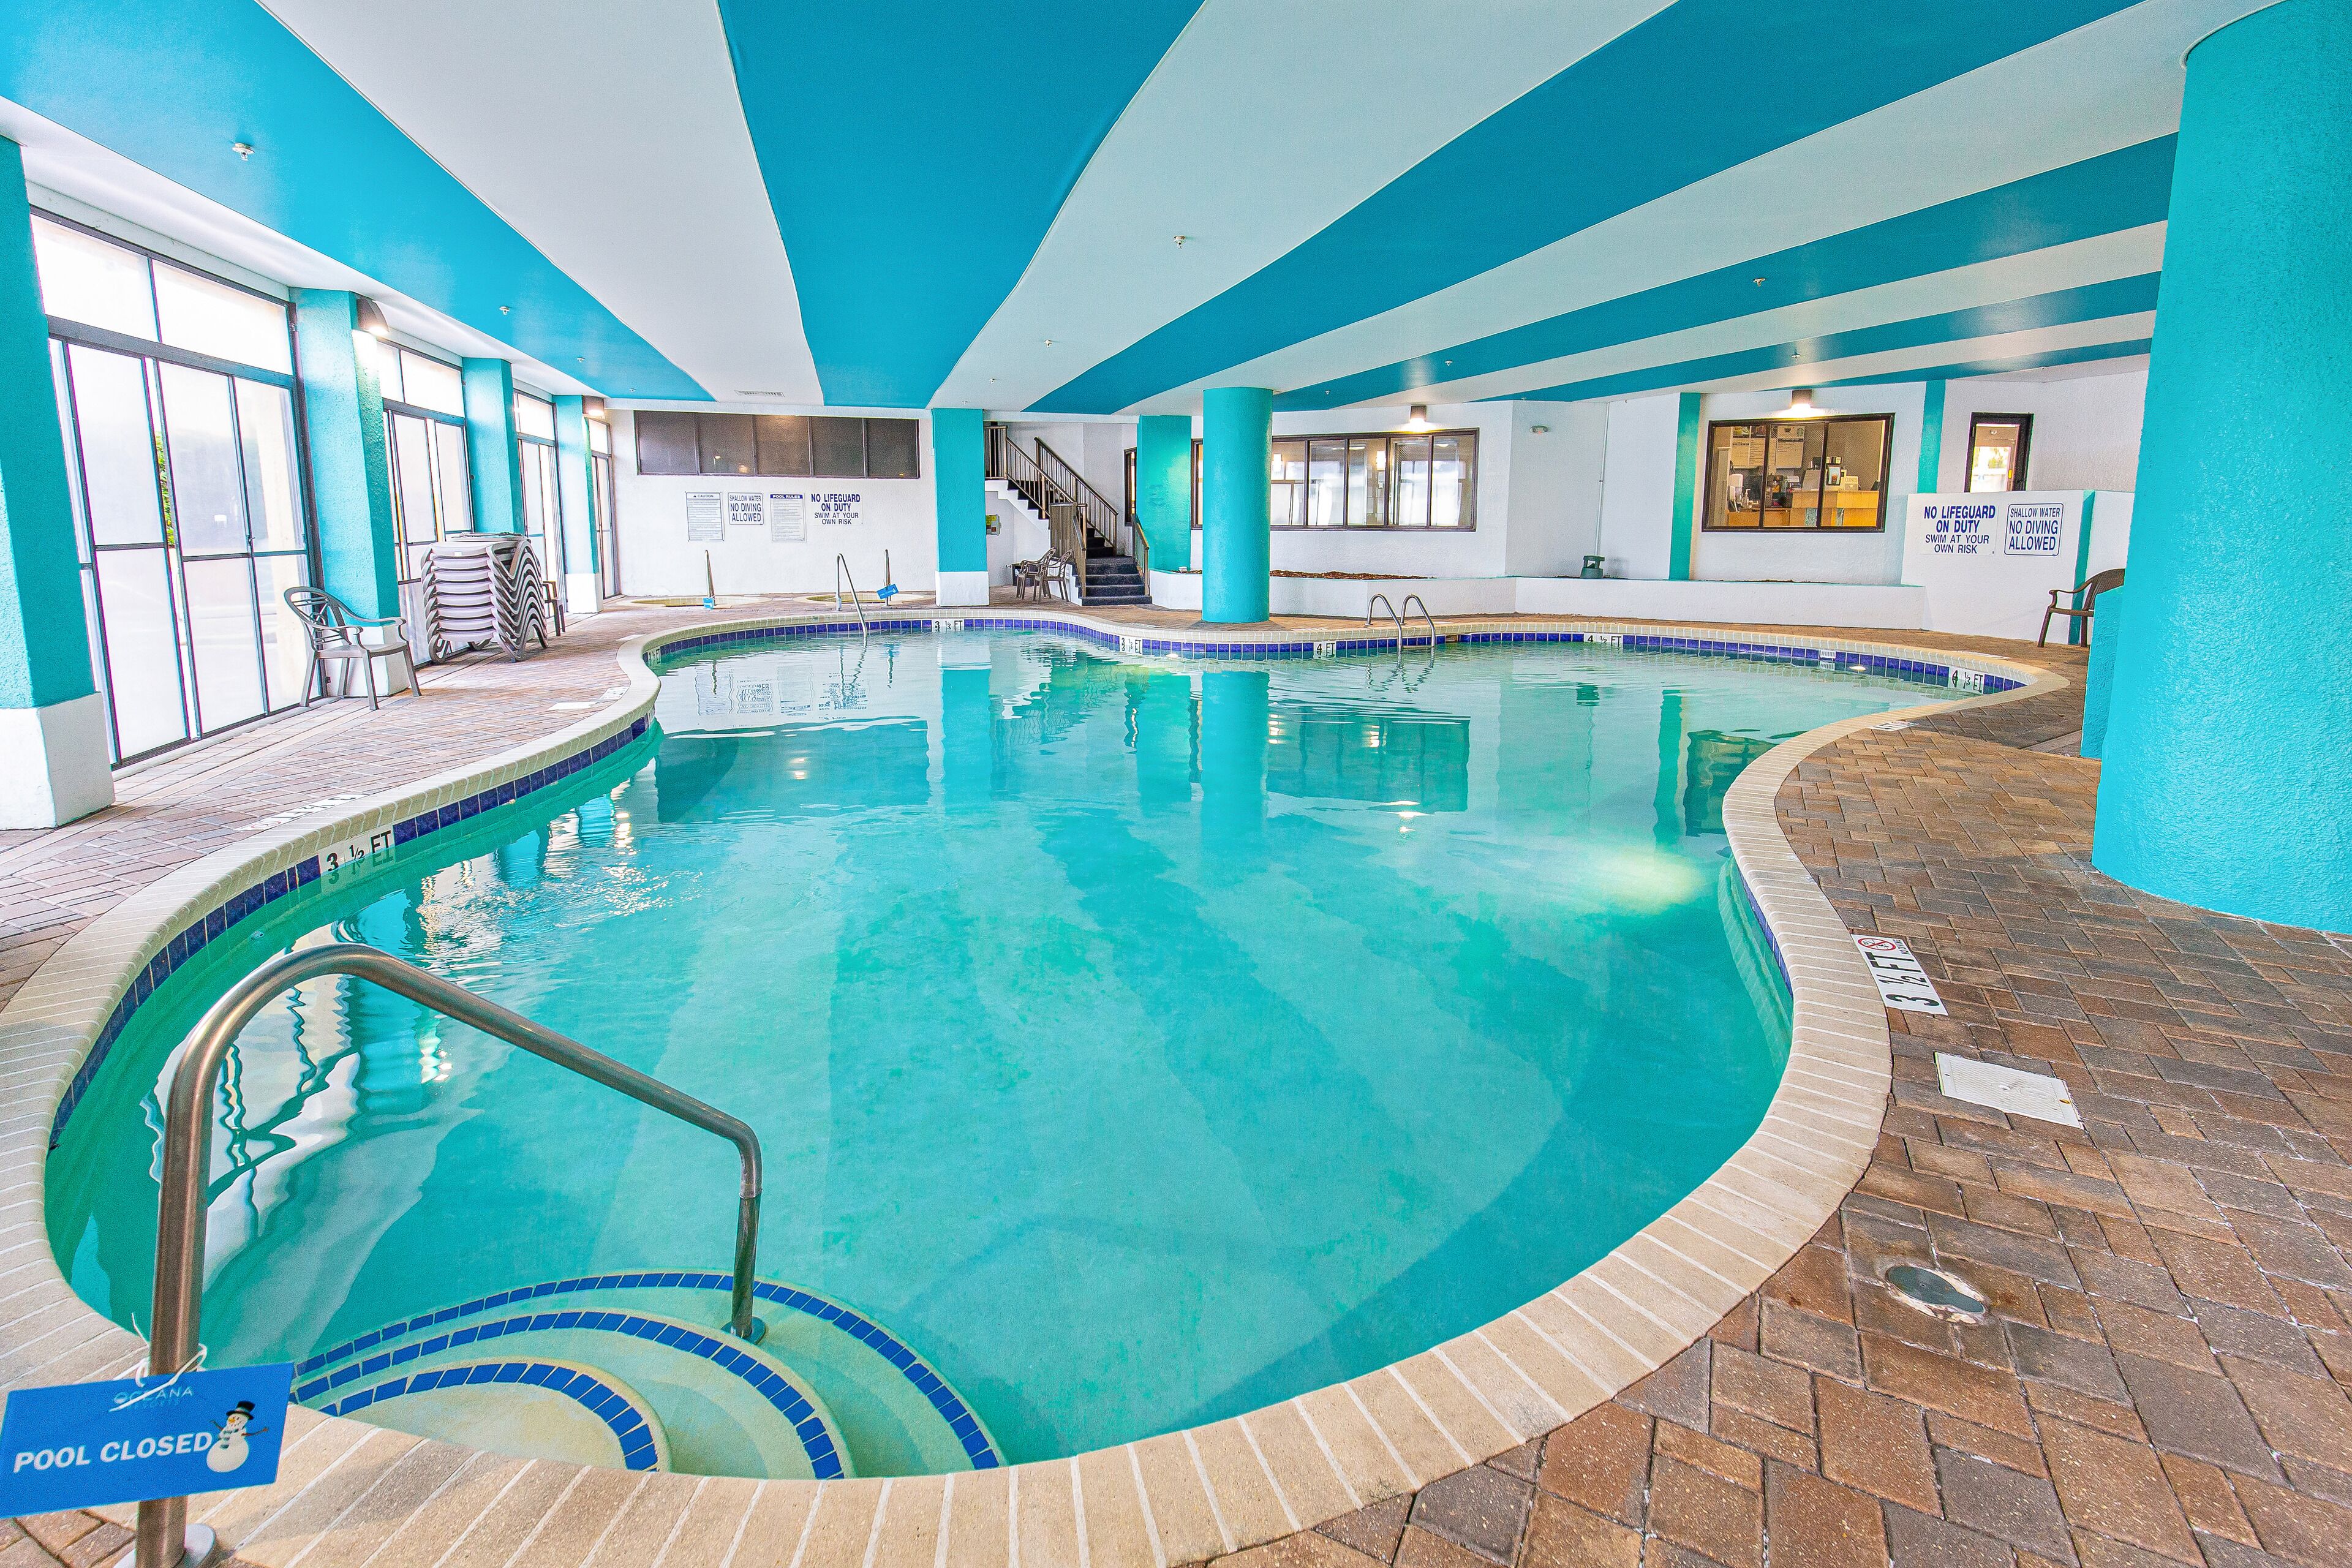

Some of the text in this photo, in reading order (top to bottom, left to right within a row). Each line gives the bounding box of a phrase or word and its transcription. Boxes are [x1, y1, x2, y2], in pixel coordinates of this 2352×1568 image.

[811, 494, 861, 503] NO LIFEGUARD
[730, 503, 761, 512] NO DIVING
[821, 503, 851, 512] ON DUTY
[1924, 505, 1996, 519] NO LIFEGUARD
[731, 513, 761, 522] ALLOWED
[2010, 508, 2060, 518] SHALLOW WATER
[1936, 519, 1980, 533] ON DUTY
[2009, 520, 2058, 534] NO DIVING
[1925, 534, 1989, 544] SWIM AT YOUR
[2008, 536, 2056, 550] ALLOWED
[1934, 544, 1978, 554] OWN RISK
[954, 620, 963, 630] FT
[1611, 636, 1622, 646] FT
[326, 852, 339, 872] 3
[370, 830, 391, 853] FT
[1865, 951, 1922, 973] FT
[1885, 993, 1940, 1006] 3
[13, 1431, 213, 1474] POOL CLOSED
